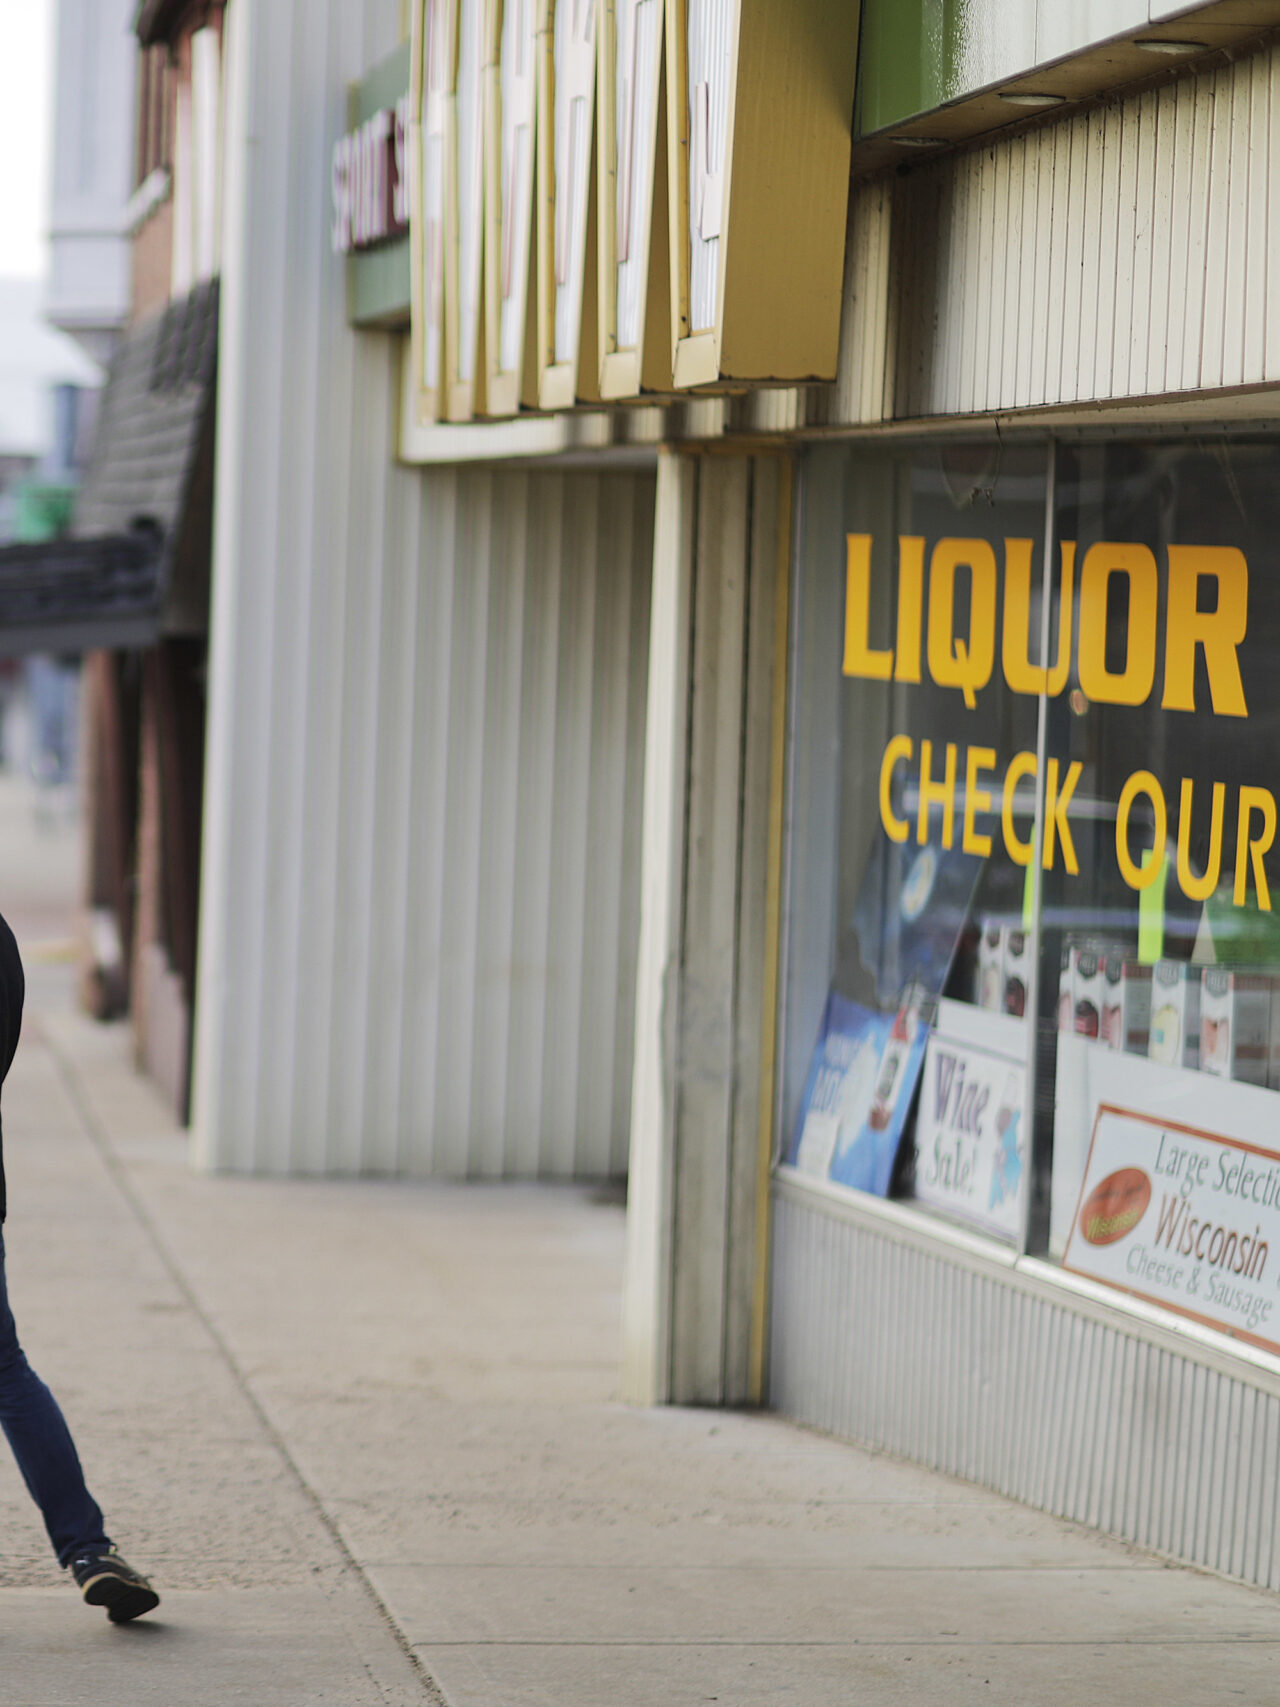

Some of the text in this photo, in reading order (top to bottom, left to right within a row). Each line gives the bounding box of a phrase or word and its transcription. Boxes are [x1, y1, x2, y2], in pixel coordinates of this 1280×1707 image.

[842, 533, 1249, 718] LIQUOR
[879, 734, 1277, 911] CHECK OUR
[935, 1052, 990, 1137] Wine
[1154, 1132, 1209, 1198] Large
[1154, 1192, 1269, 1282] Wisconsin
[1125, 1243, 1273, 1331] Cheese & Sausage
